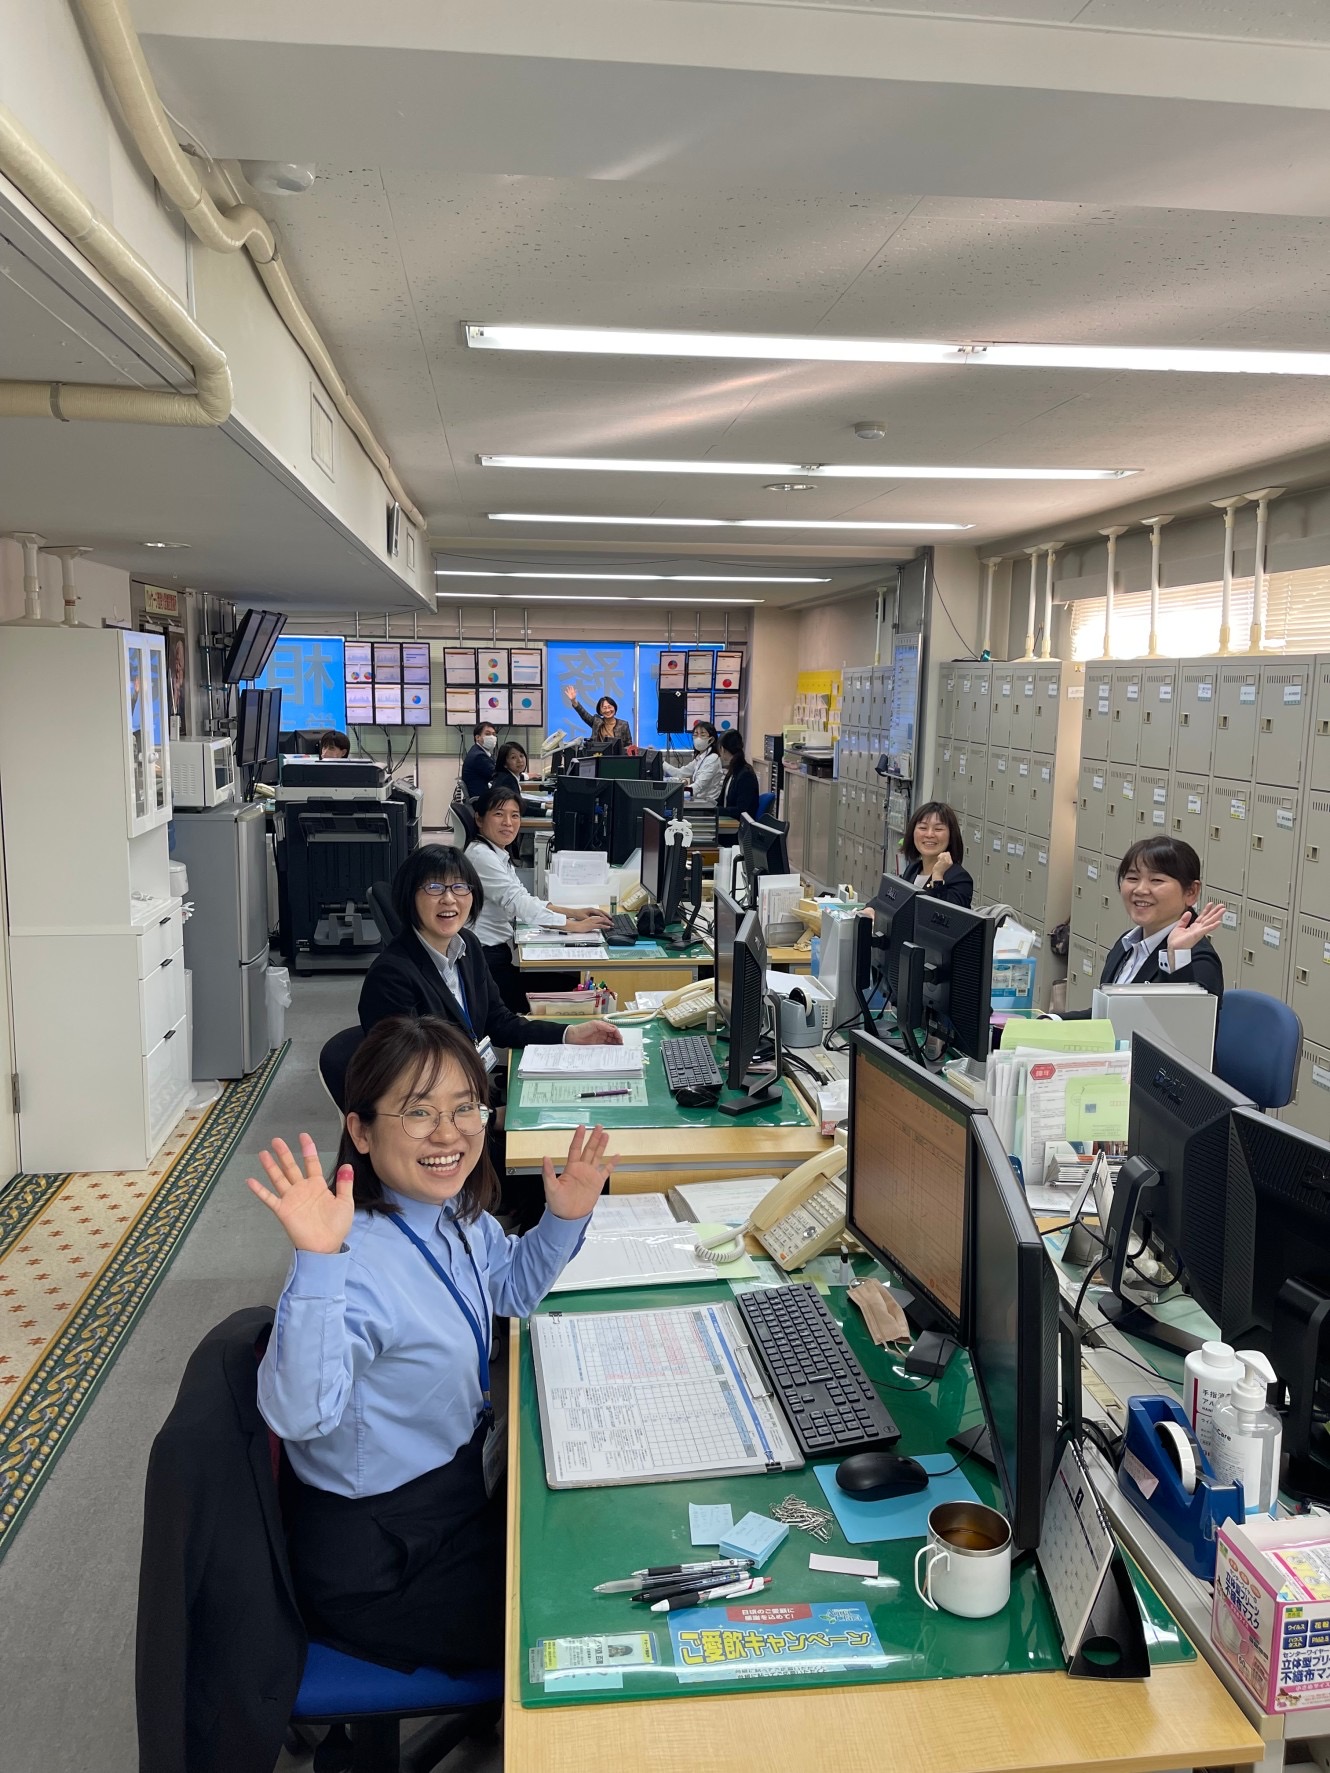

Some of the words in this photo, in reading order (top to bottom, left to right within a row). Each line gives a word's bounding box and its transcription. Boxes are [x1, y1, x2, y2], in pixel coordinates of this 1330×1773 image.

[1287, 1623, 1306, 1631] ウイルス
[1314, 1620, 1329, 1629] 花粉
[1311, 1636, 1330, 1644] PM2.5
[679, 1629, 872, 1666] ご愛飲キャンペーン
